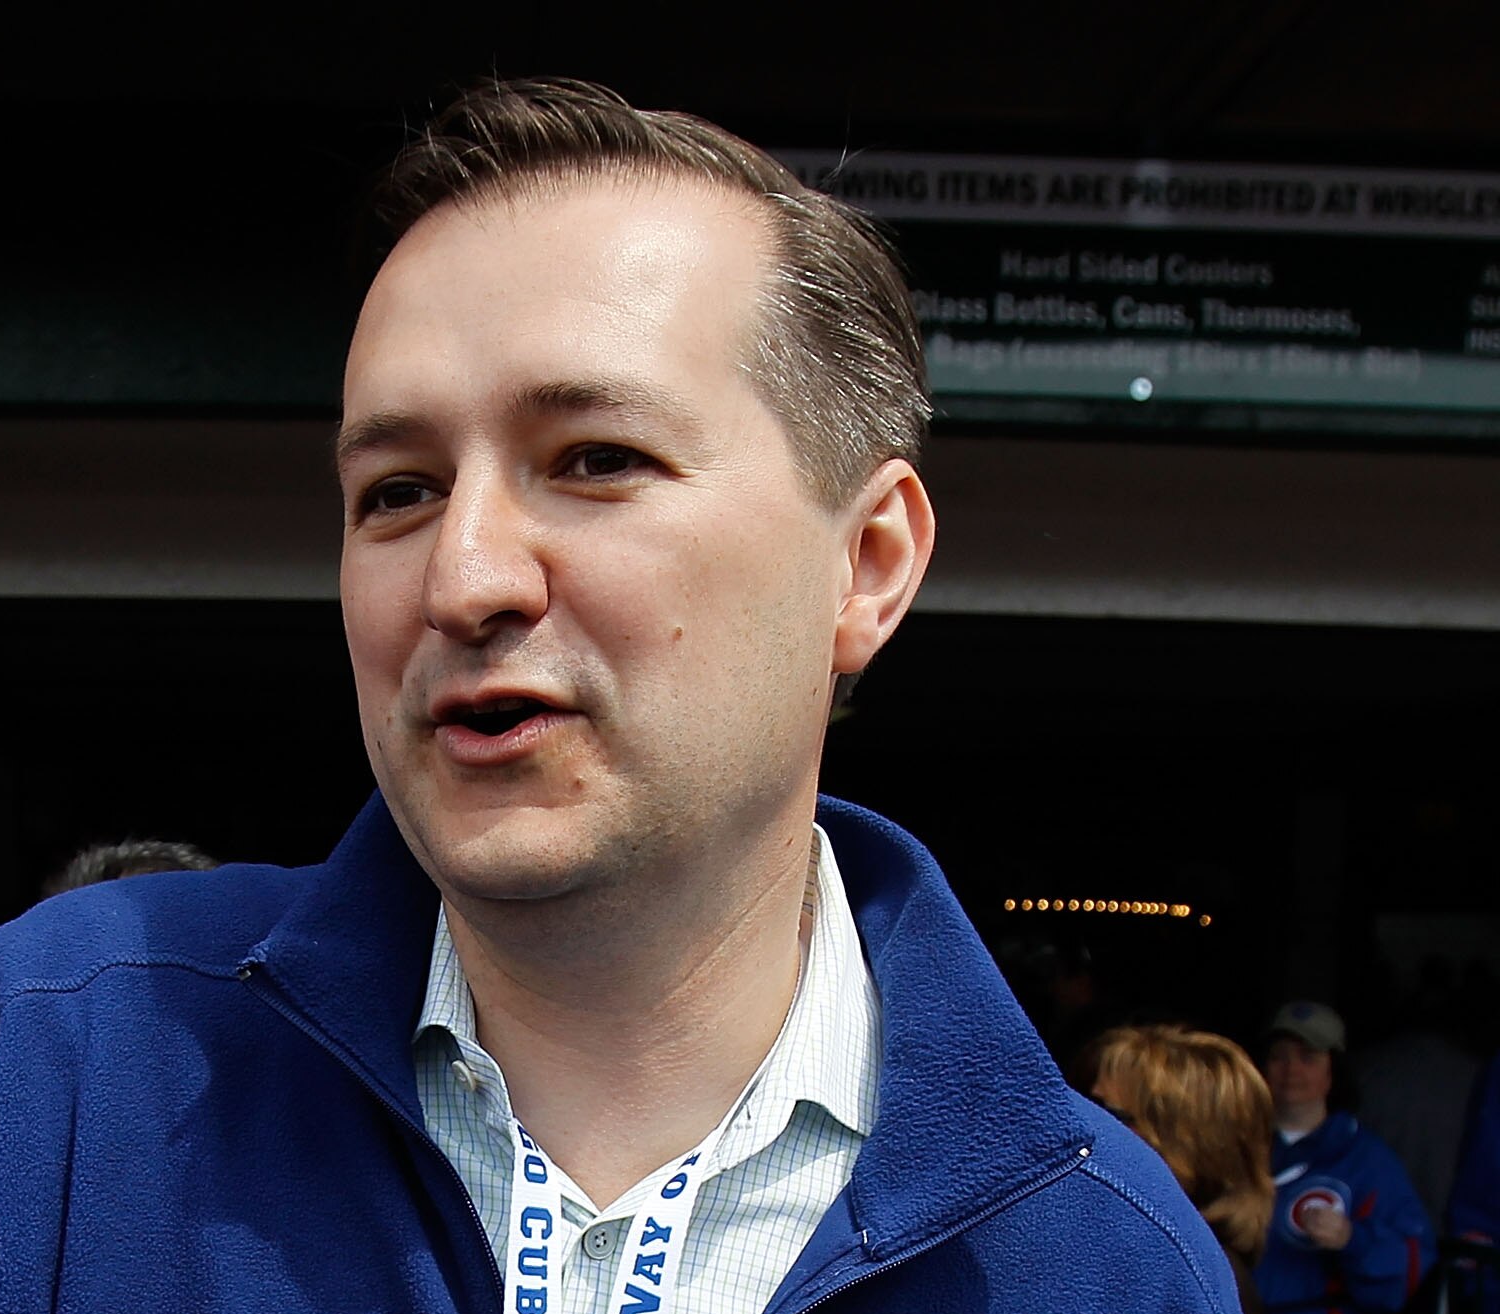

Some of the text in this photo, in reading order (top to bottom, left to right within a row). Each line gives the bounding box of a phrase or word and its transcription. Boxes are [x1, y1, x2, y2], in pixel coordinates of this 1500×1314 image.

[937, 170, 1038, 208] ITEMS
[1046, 173, 1111, 209] ARE
[1120, 176, 1317, 214] PROHIBITED
[1323, 179, 1361, 213] AT
[1370, 184, 1500, 219] WRIGLE
[1000, 250, 1275, 288] Hard Sided Coolers
[1112, 295, 1195, 333] Cans,
[1201, 298, 1362, 338] Thermoses,
